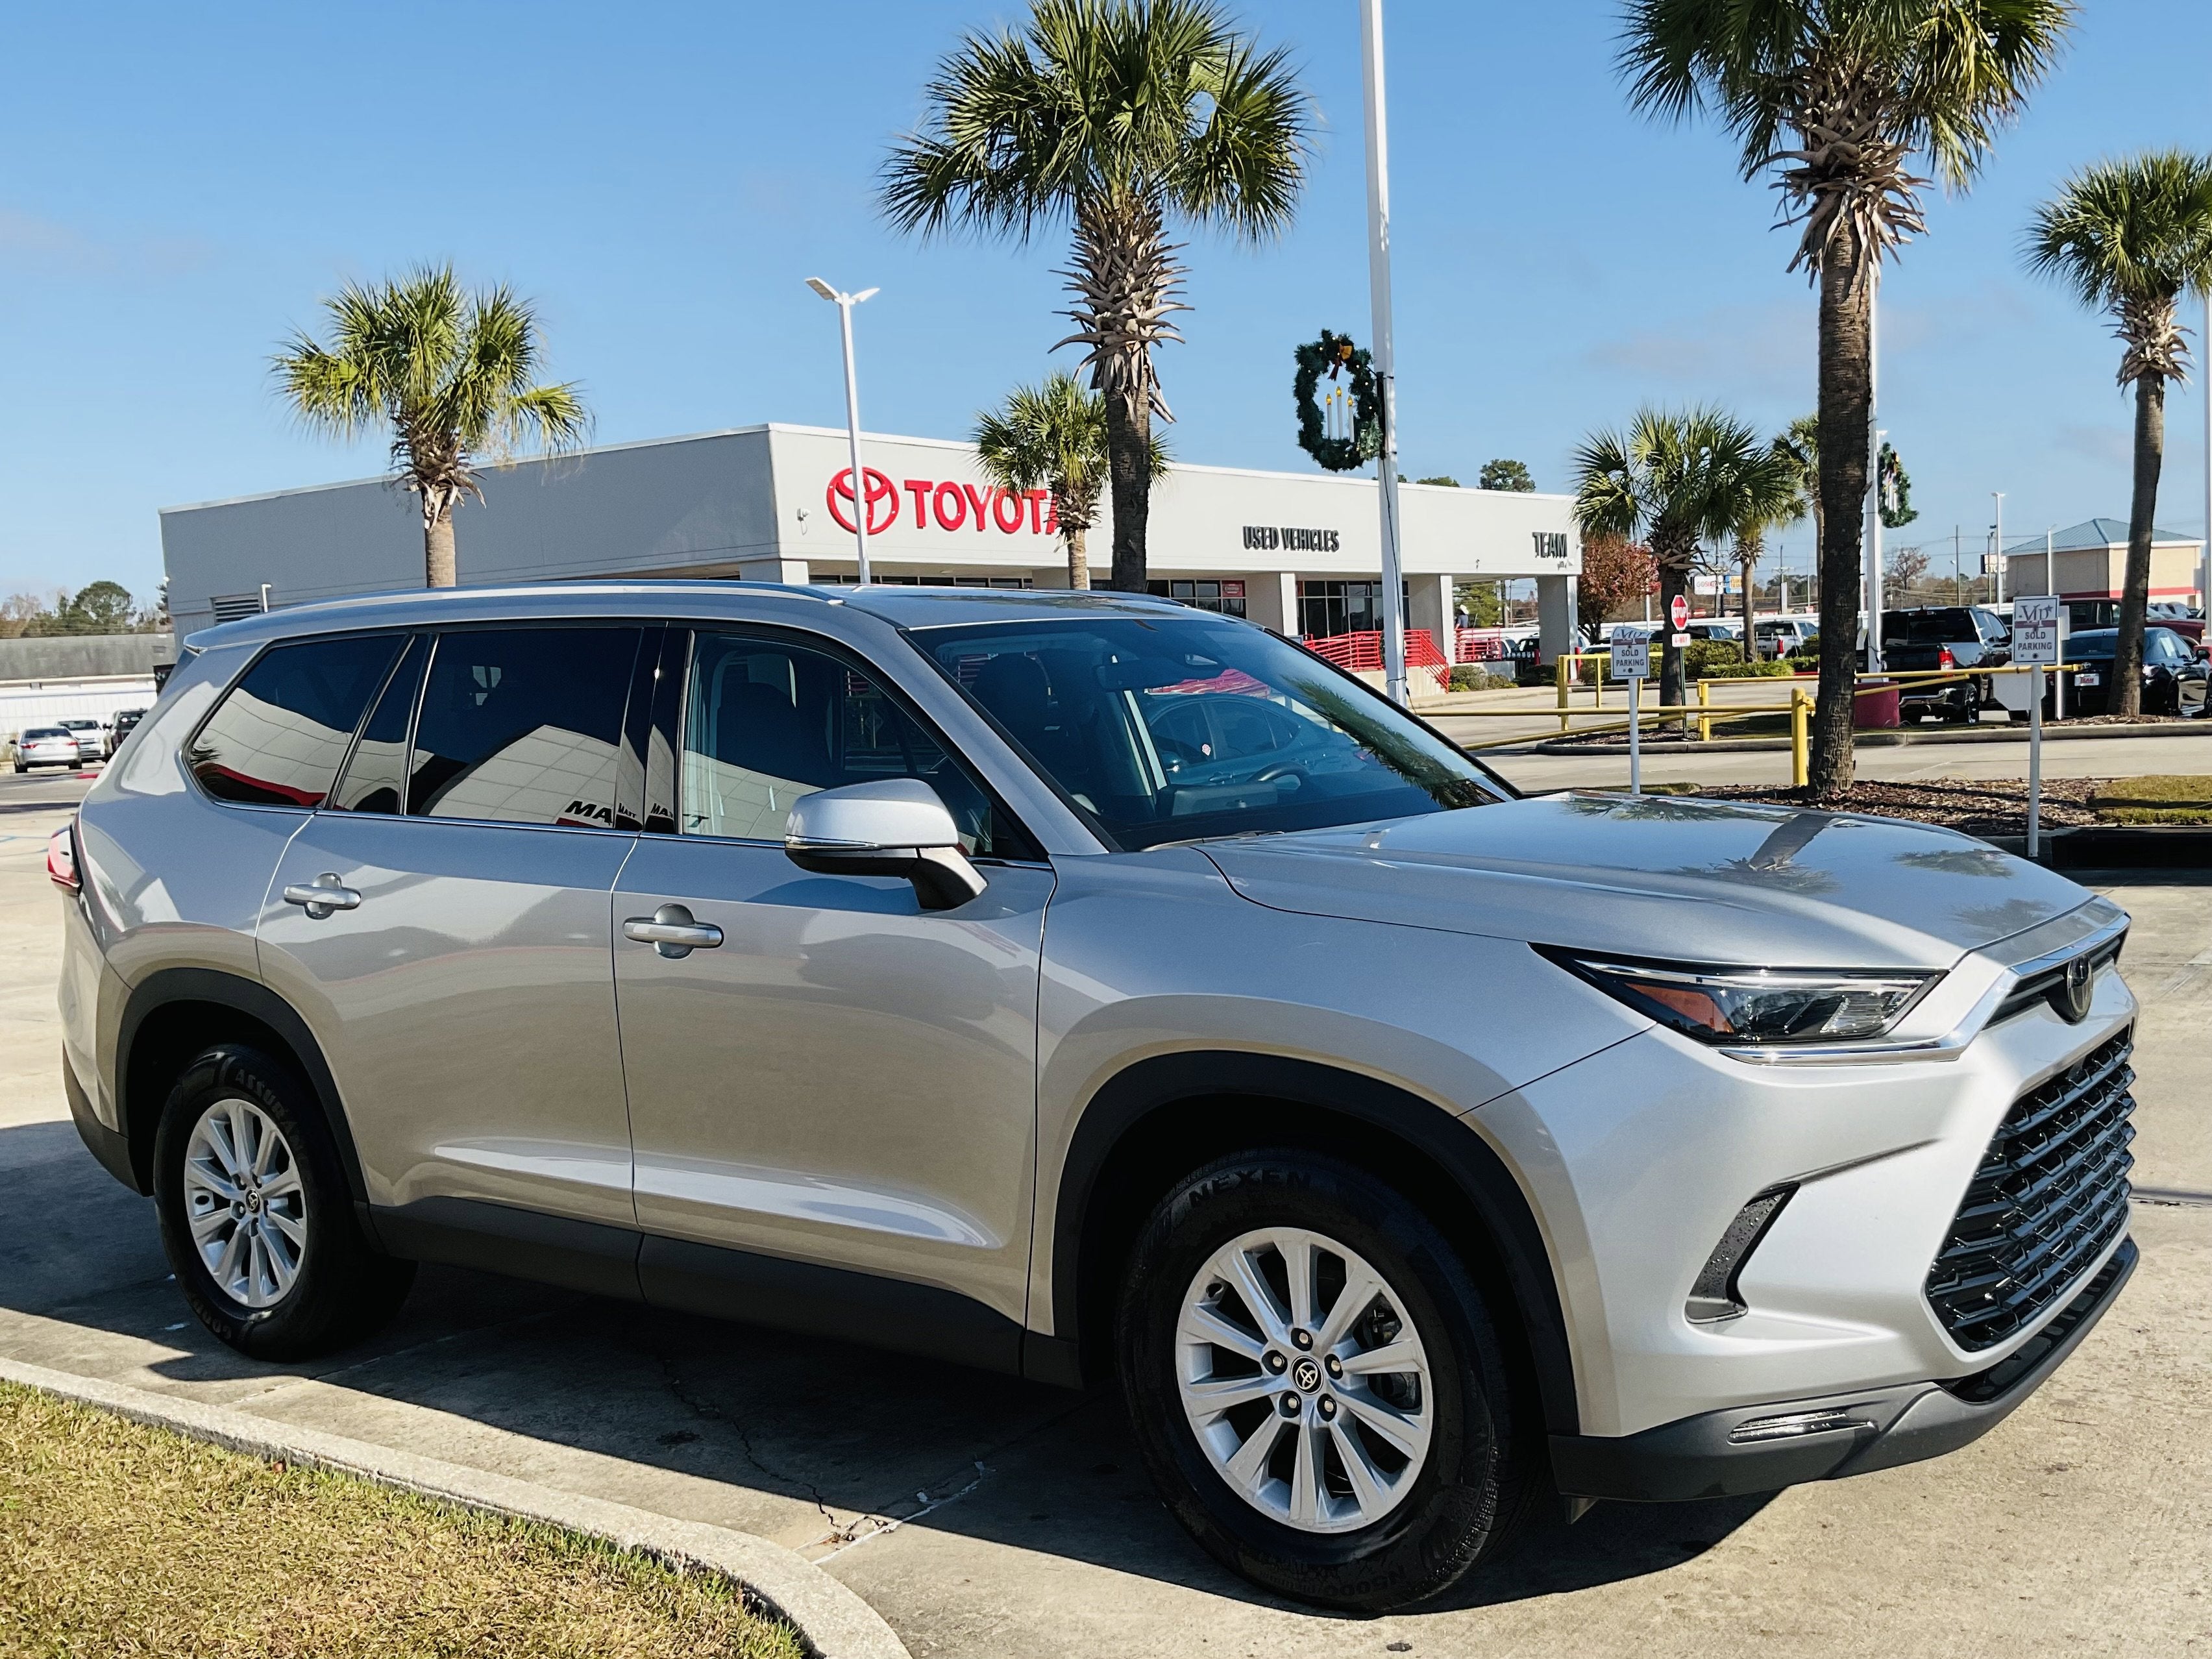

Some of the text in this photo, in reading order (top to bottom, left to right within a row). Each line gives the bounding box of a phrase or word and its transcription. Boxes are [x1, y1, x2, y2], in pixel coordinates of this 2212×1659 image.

[1243, 526, 1339, 552] USED VEHICLES
[1532, 532, 1567, 558] TEAM
[1673, 606, 1687, 618] STOP
[1189, 1168, 1311, 1208] NEXEN
